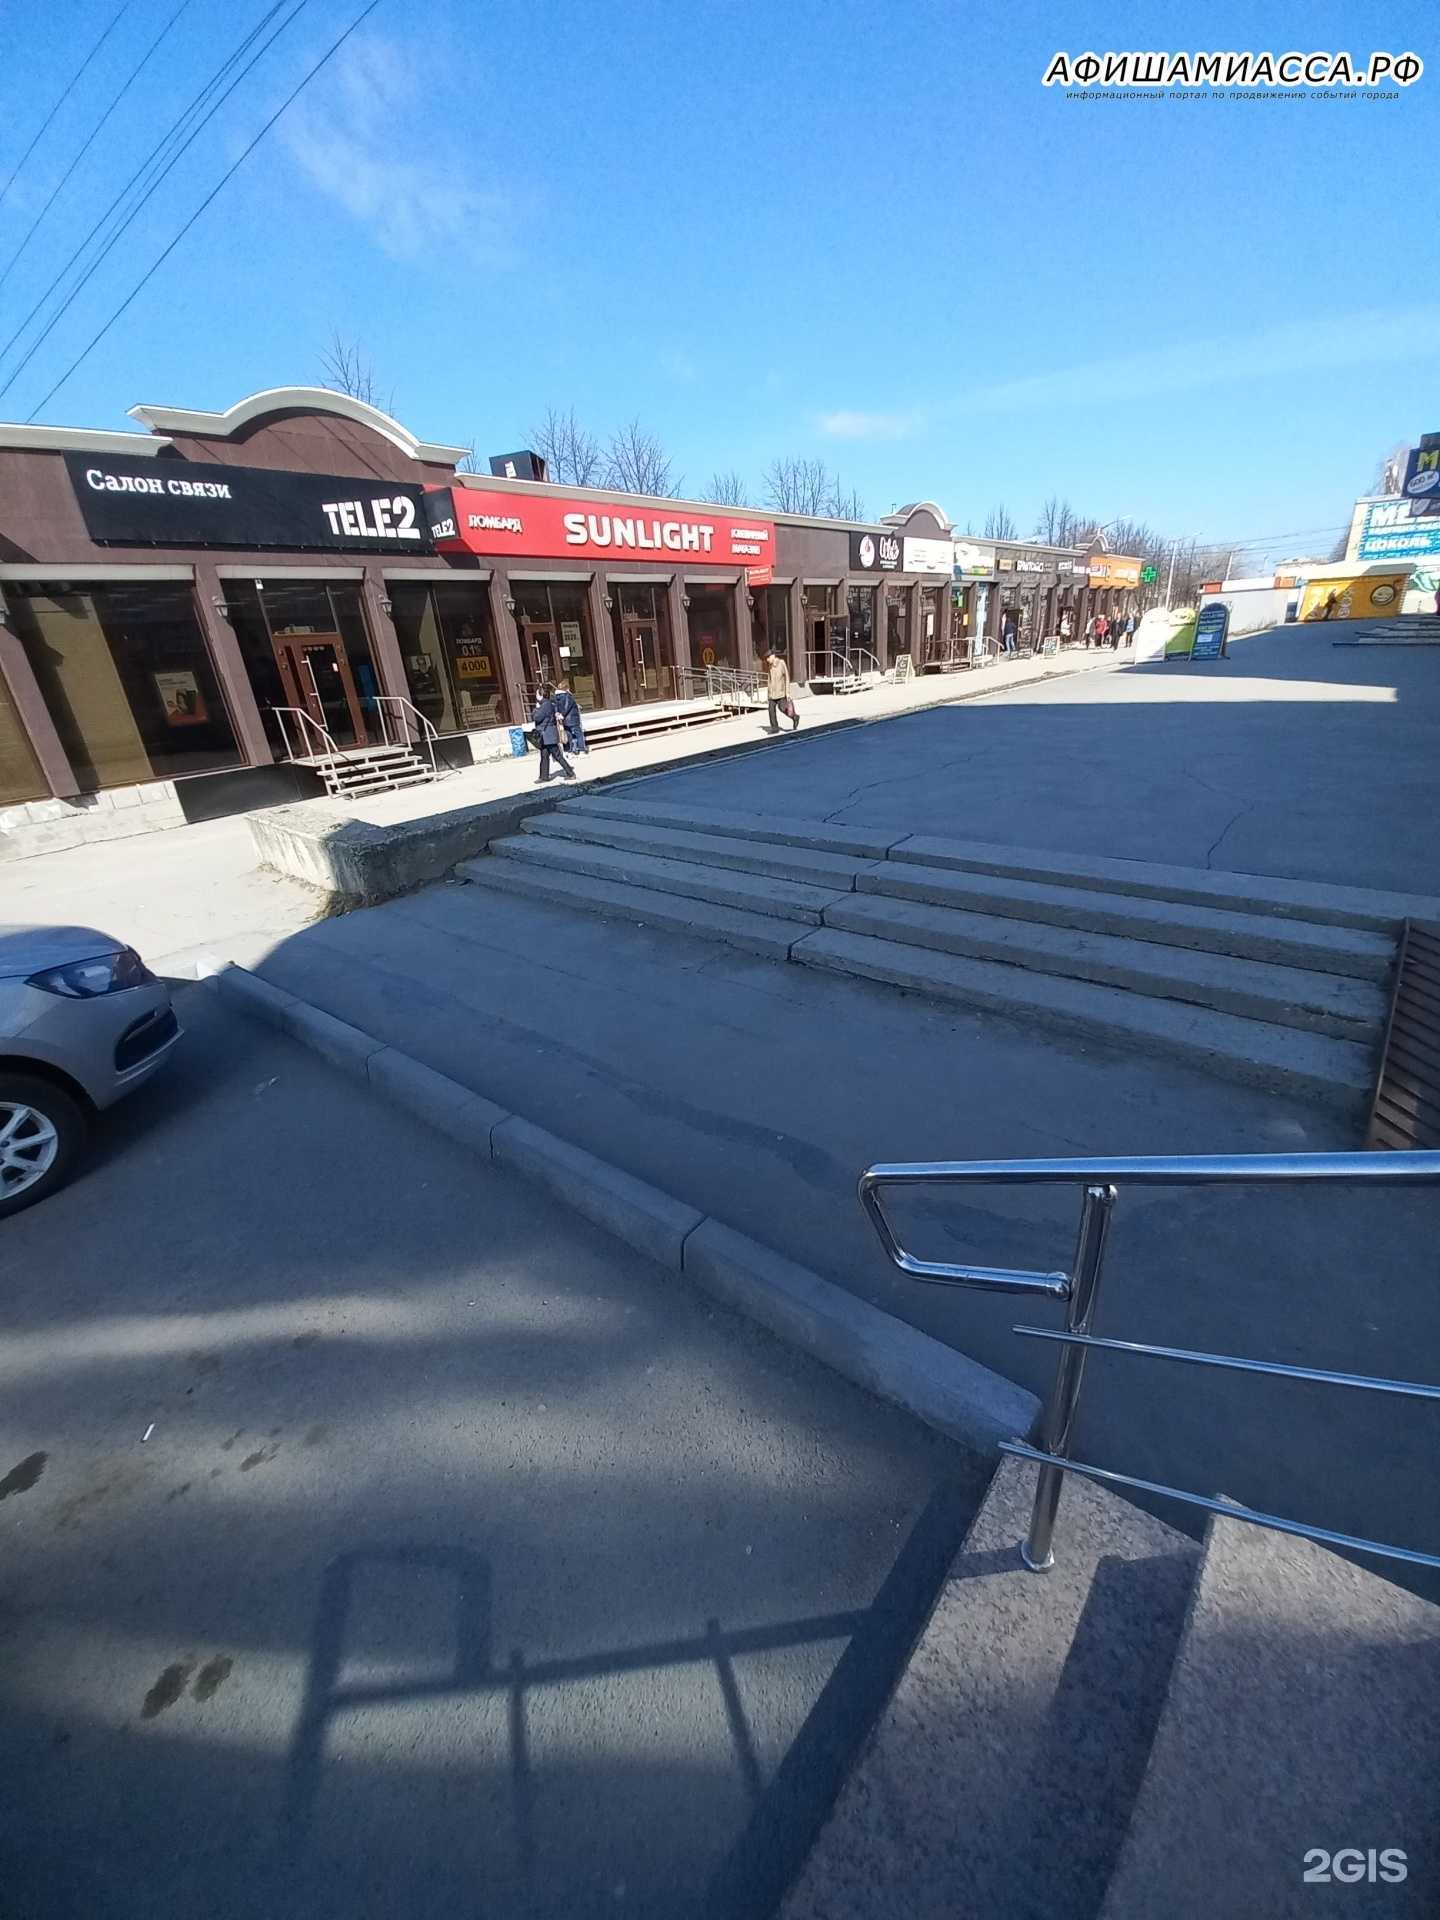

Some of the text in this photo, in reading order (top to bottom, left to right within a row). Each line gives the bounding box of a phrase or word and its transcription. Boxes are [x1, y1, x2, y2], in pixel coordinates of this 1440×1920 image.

[86, 469, 232, 500] Салон связи
[321, 495, 420, 540] TELE2
[431, 517, 456, 539] TELE2
[467, 513, 522, 533] ЛОМБАРД
[563, 513, 714, 552] SUNLIGHT
